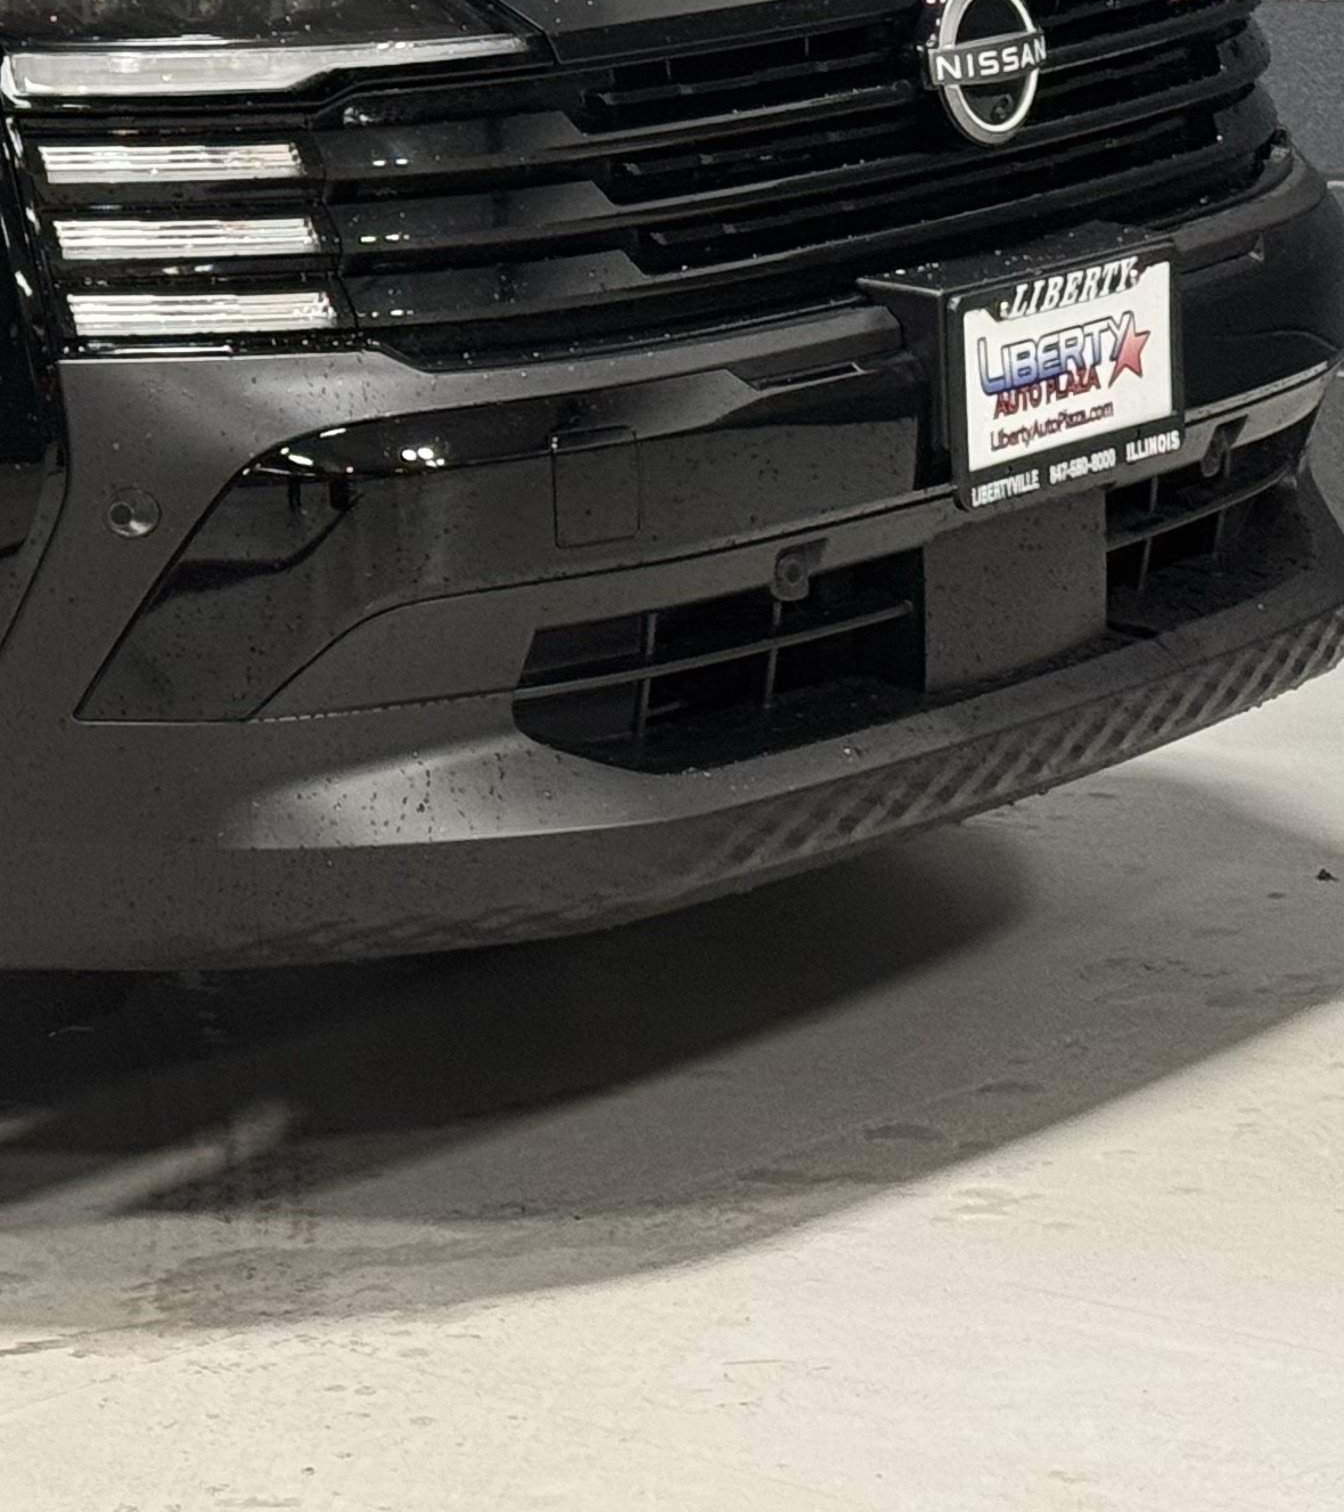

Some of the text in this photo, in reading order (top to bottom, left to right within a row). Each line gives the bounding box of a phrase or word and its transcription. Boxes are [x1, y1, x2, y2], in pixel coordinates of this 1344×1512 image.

[936, 35, 1047, 82] NISSAN
[1011, 256, 1139, 318] LIBERTY
[977, 310, 1136, 396] LIBERTY
[993, 366, 1101, 419] AUTO PLAZA
[971, 469, 1041, 508] LIBERTYVILLE
[1125, 430, 1181, 462] ILLINOIS
